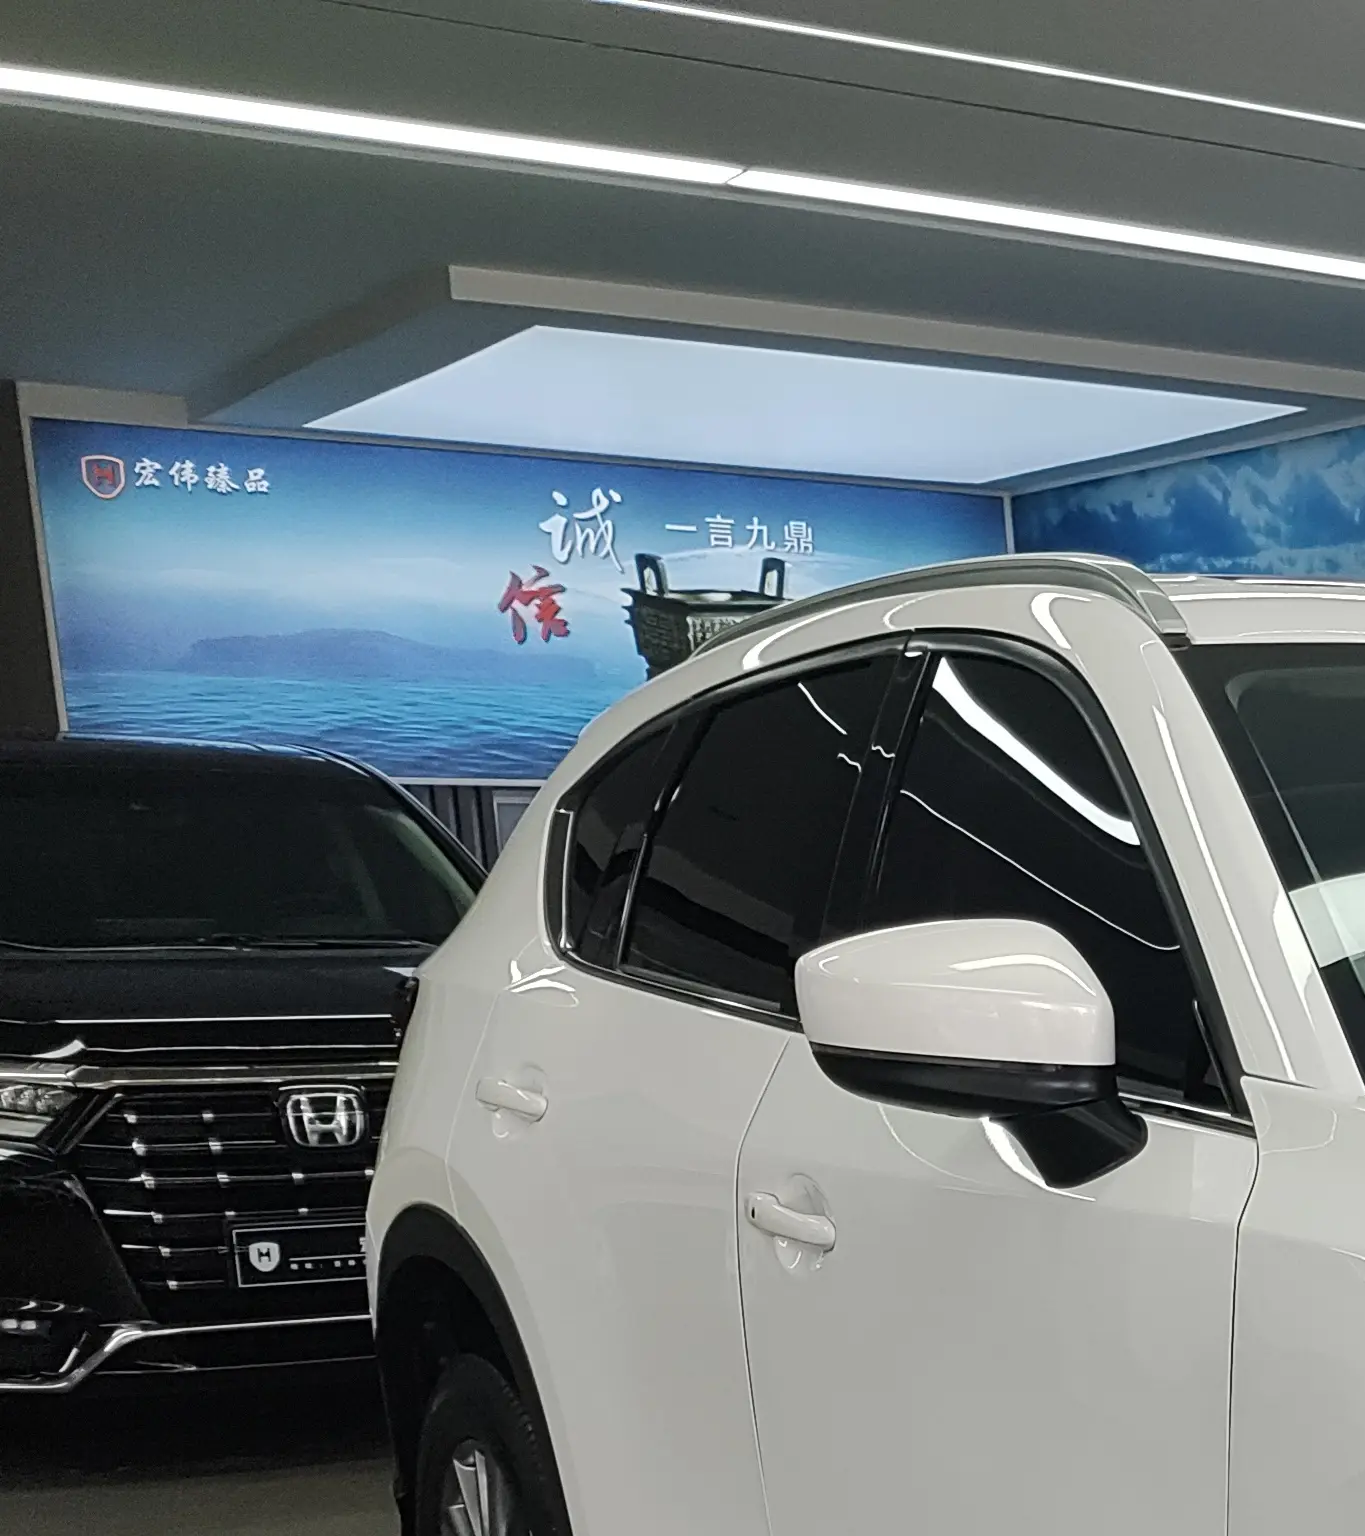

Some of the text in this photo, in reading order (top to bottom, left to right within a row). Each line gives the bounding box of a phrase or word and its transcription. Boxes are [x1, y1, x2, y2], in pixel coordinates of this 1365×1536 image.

[133, 457, 270, 495] 宏伟臻品
[664, 513, 815, 554] 一言九鼎
